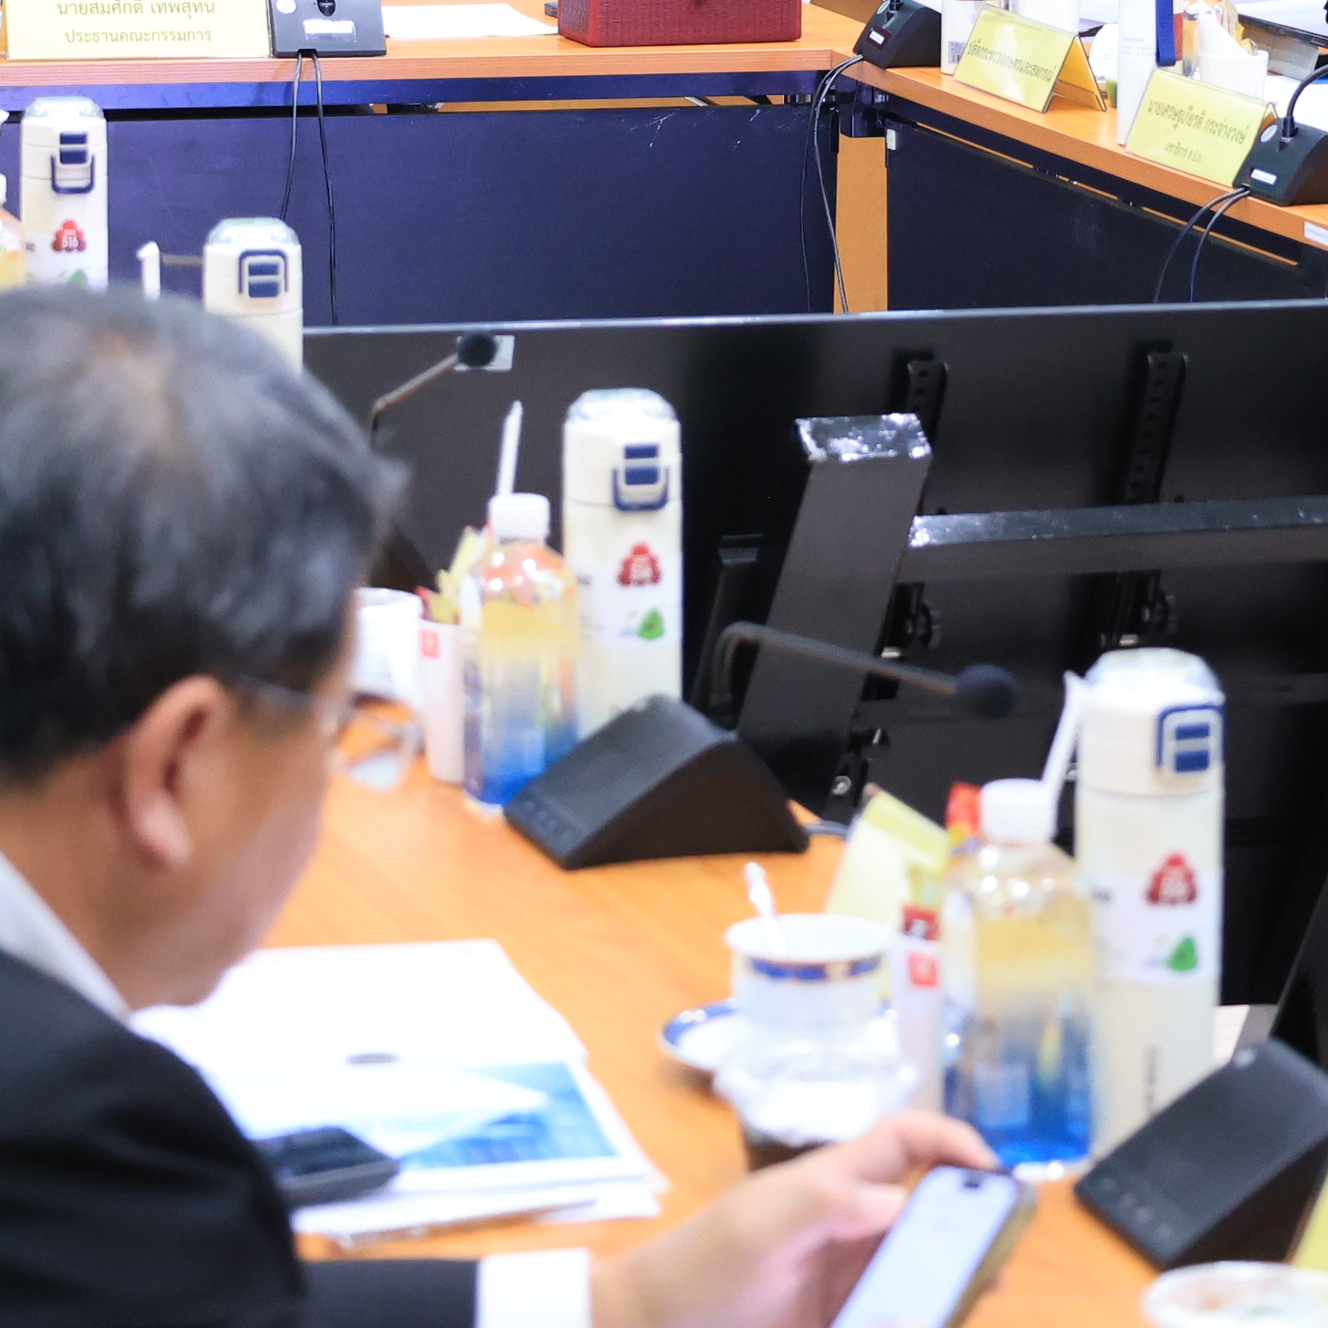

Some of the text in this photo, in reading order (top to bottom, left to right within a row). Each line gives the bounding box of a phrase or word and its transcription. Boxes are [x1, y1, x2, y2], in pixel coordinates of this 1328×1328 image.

[64, 28, 213, 43] ประธานคณะกรรมการ
